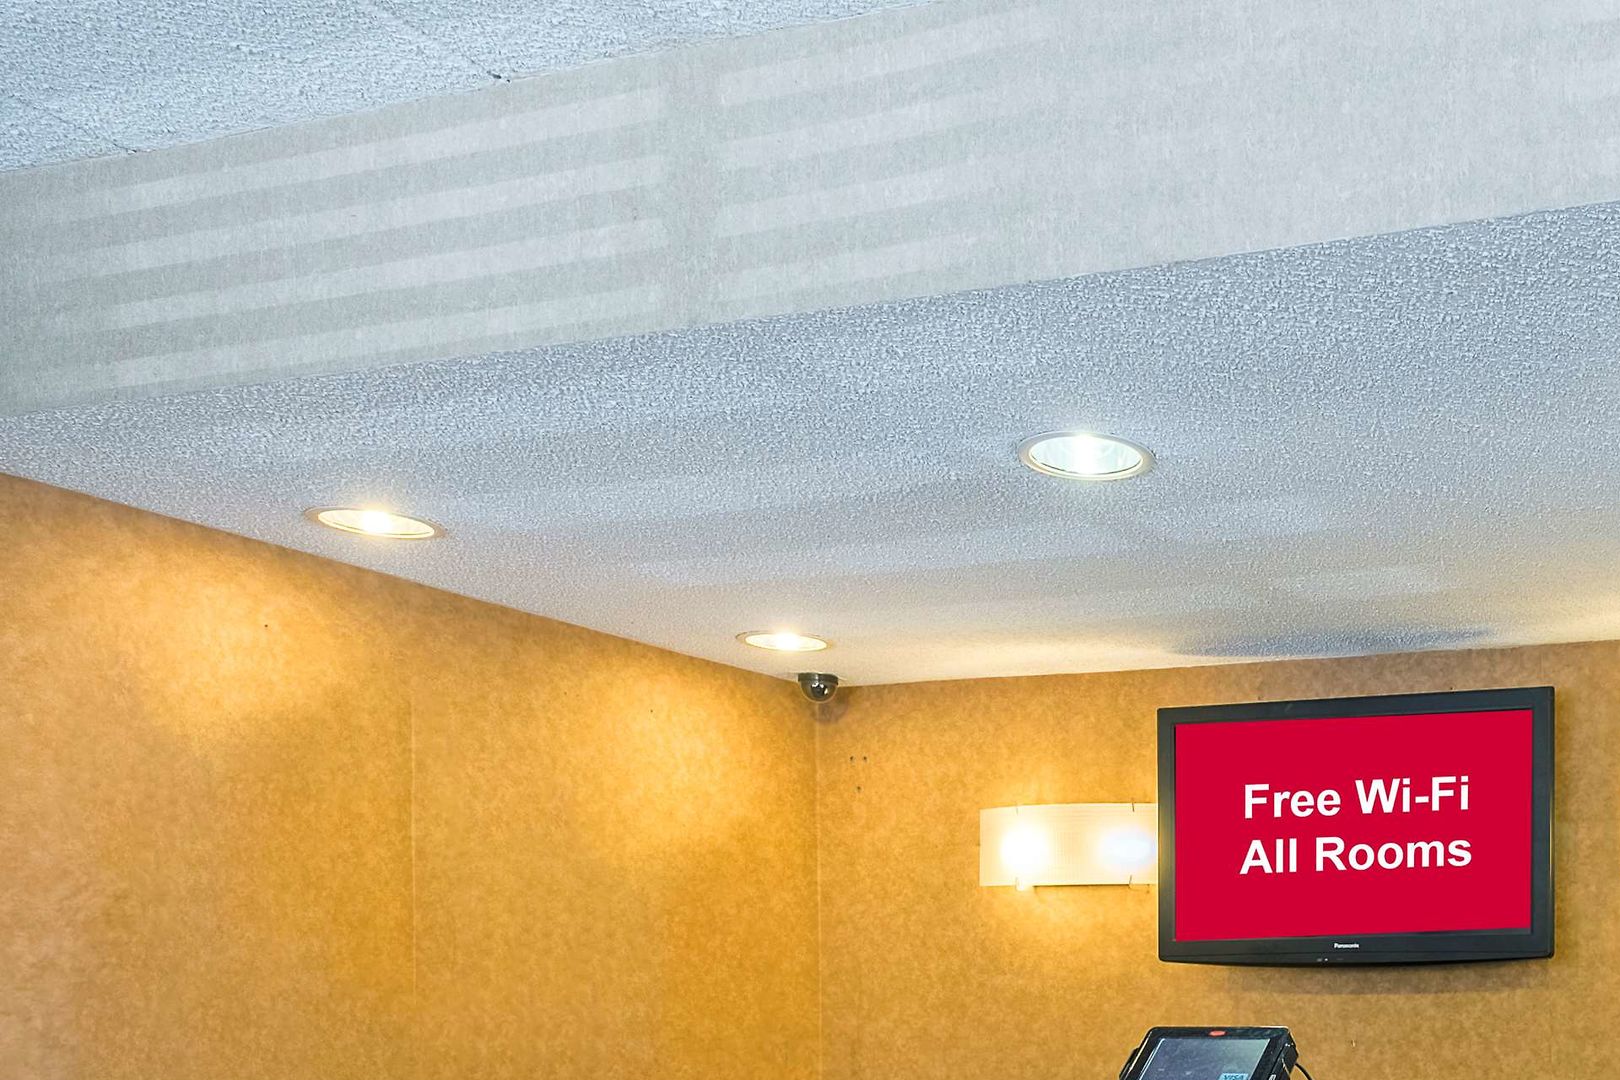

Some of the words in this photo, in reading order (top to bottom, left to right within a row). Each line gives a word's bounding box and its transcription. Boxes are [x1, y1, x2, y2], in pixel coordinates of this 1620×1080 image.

[1244, 783, 1341, 819] Free
[1355, 776, 1469, 814] Wi-Fi
[1239, 837, 1297, 875] All
[1315, 836, 1472, 872] Rooms
